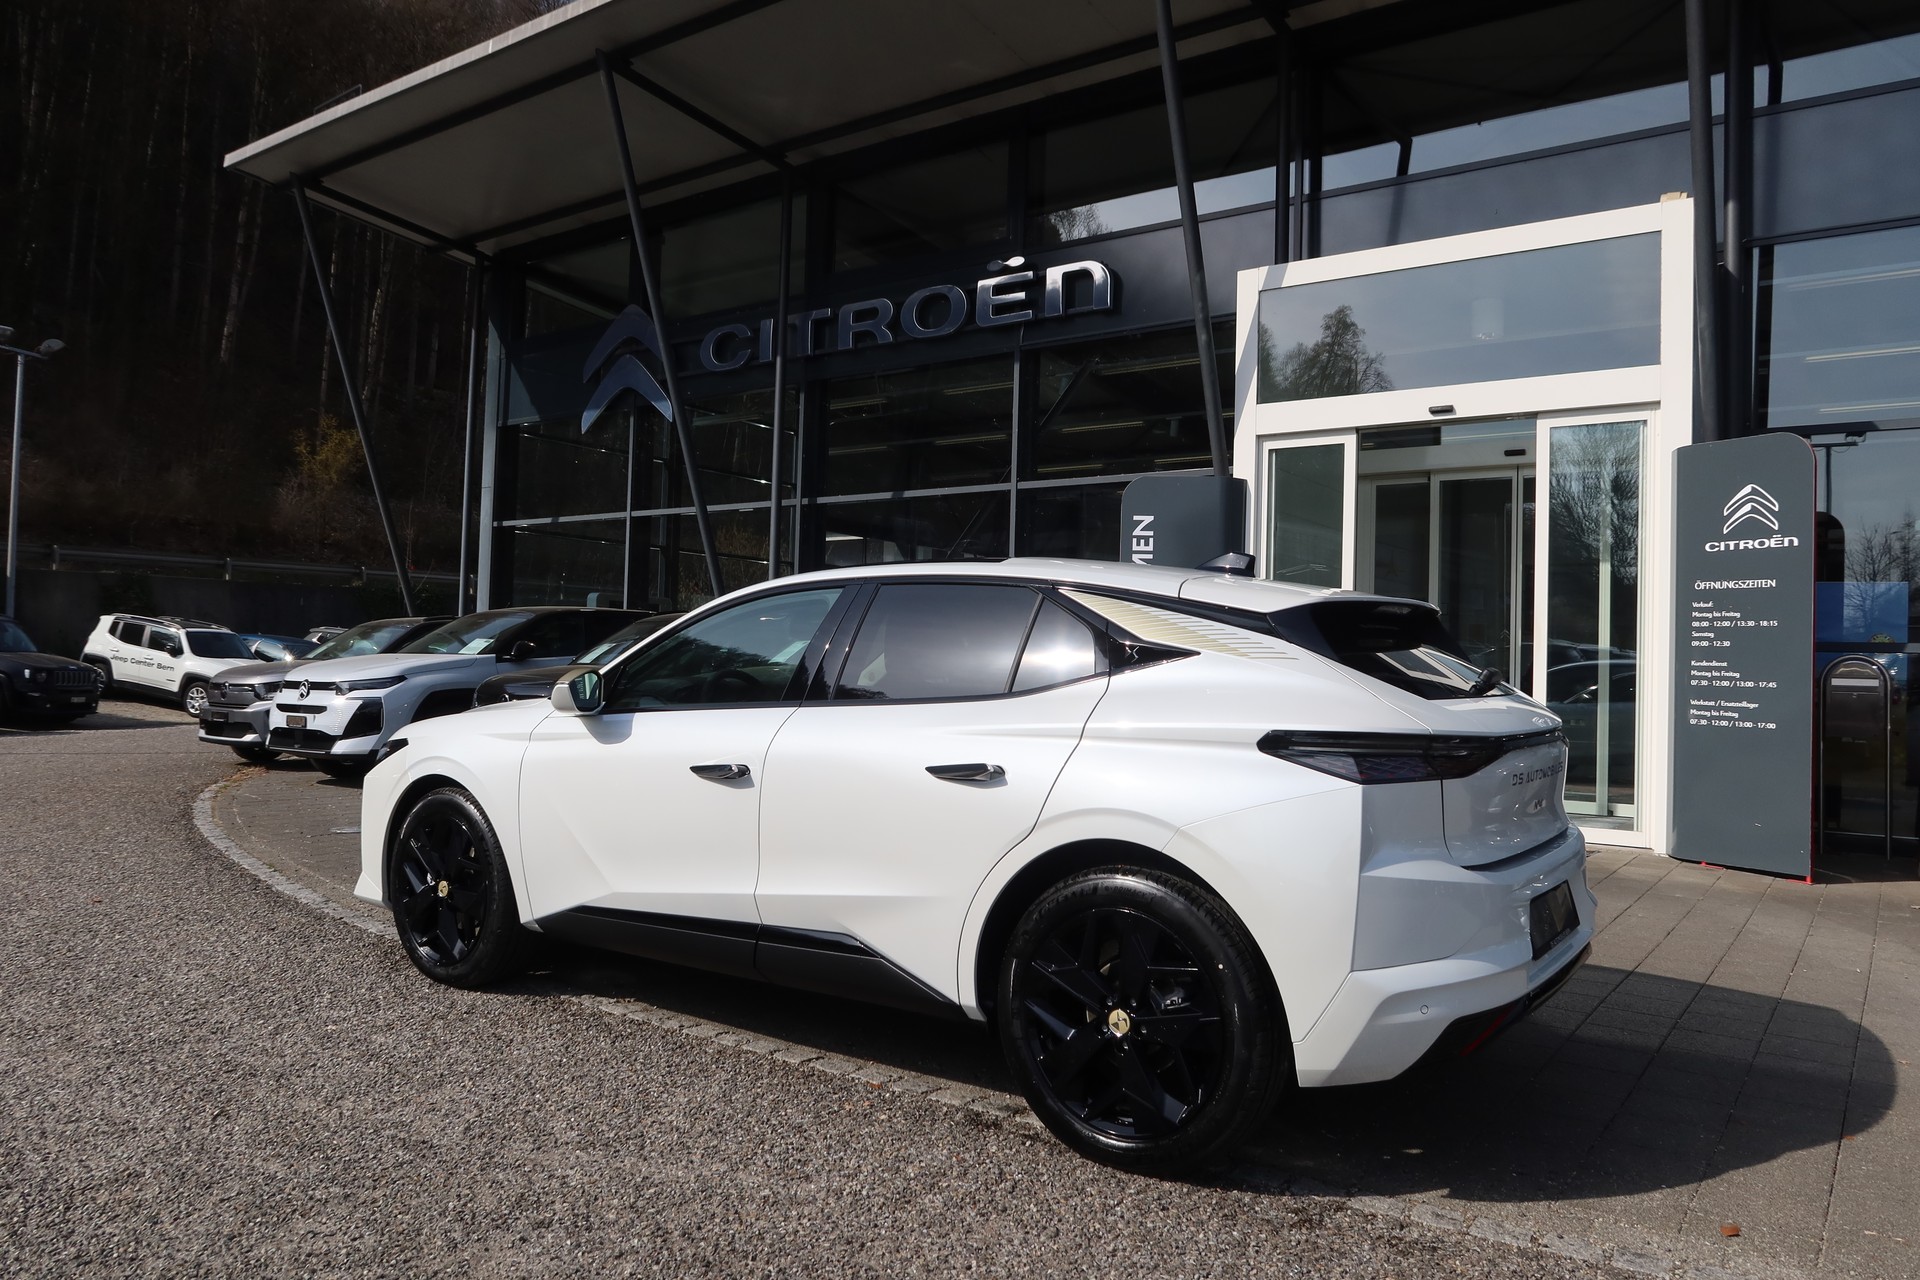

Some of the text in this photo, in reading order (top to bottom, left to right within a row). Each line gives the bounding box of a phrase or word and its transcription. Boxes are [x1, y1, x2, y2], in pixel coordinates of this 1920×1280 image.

[699, 256, 1112, 372] CITROËN
[1704, 534, 1799, 552] CITROËN
[1694, 579, 1777, 590] ÖFFNUNGSZEITEN
[110, 654, 175, 672] Jeep Center Bern
[1689, 709, 1711, 717] Montag
[1512, 761, 1563, 786] DS AUTOMOBILES
